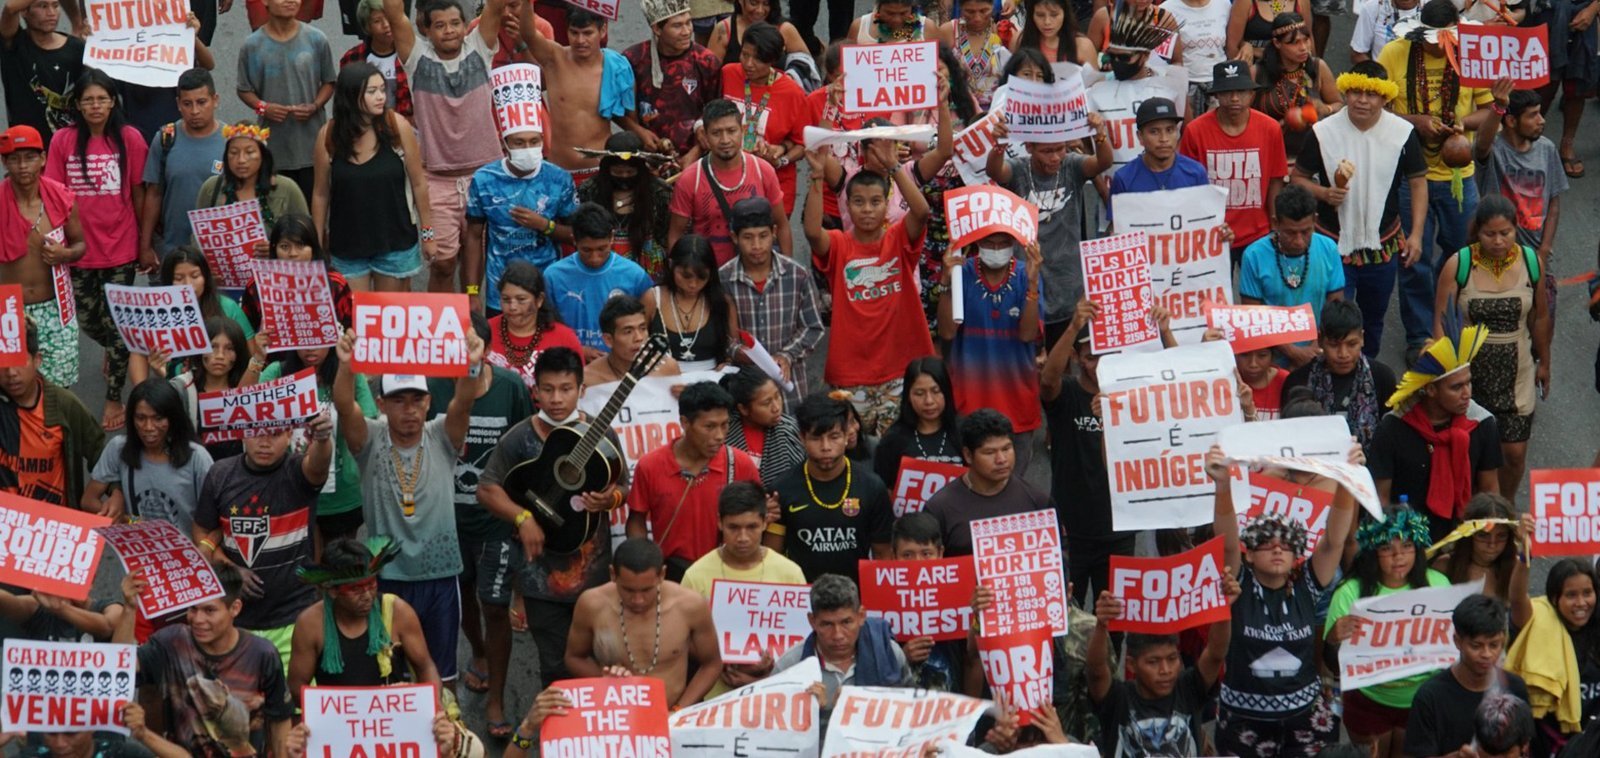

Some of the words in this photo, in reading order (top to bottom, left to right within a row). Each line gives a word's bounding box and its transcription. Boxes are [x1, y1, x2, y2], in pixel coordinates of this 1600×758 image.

[90, 0, 189, 31] FUTURO
[90, 44, 188, 65] INDÍGENA
[855, 50, 883, 65] WE
[890, 47, 925, 62] ARE
[1460, 35, 1546, 61] FORA
[874, 67, 908, 82] THE
[1460, 58, 1548, 80] GRILAGEM!
[857, 84, 926, 107] LAND
[1206, 151, 1262, 180] LUTA
[947, 192, 1034, 228] FORA
[195, 221, 228, 234] PLs
[231, 214, 259, 229] DA
[1171, 215, 1182, 230] O
[200, 226, 265, 249] MORTE:
[1147, 226, 1223, 266] UTURO
[1087, 256, 1119, 274] PLs
[1124, 248, 1147, 264] DA
[258, 271, 290, 289] PLs
[294, 274, 326, 290] DA
[1087, 265, 1151, 292] MORTE:
[1171, 268, 1183, 286] É
[260, 287, 330, 303] MORTE:
[848, 281, 902, 301] LACOSTE
[1102, 293, 1117, 304] PL
[1119, 290, 1133, 302] 191
[356, 305, 464, 338] FORA
[1106, 325, 1120, 336] PL
[1241, 322, 1310, 338] TERRAS!
[120, 326, 207, 354] VENENO
[354, 338, 467, 365] GRILAGEM!
[1161, 369, 1175, 381] O
[223, 383, 297, 408] MOTHER
[1107, 378, 1233, 426] FUTURO
[203, 389, 317, 426] EARTH
[205, 429, 237, 444] ALL
[1169, 424, 1183, 447] É
[233, 516, 267, 533] SPFC
[798, 527, 857, 546] QATAR
[812, 539, 858, 553] AIRWAYS
[978, 537, 1016, 556] PLs
[1023, 529, 1055, 549] DA
[15, 554, 88, 585] TERRAS!
[876, 568, 909, 586] WE
[916, 564, 959, 586] ARE
[979, 552, 1060, 577] MORTE:
[993, 578, 1010, 589] PL
[1013, 574, 1031, 586] 191
[1113, 553, 1220, 600] FORA
[152, 585, 169, 597] PL
[728, 588, 760, 606] WE
[767, 591, 809, 609] ARE
[896, 588, 938, 608] THE
[995, 590, 1011, 601] PL
[1015, 587, 1037, 599] 490
[997, 602, 1013, 614] PL
[1016, 597, 1046, 611] 2833
[1411, 604, 1426, 616] O
[748, 610, 787, 629] THE
[998, 614, 1014, 626] PL
[1018, 610, 1037, 622] 510
[1350, 617, 1452, 647] FUTUR
[7, 647, 105, 668] GARIMPO
[118, 650, 131, 669] É
[321, 695, 357, 714] WE
[368, 693, 417, 713] ARE
[563, 686, 595, 708] WE
[604, 685, 651, 706] ARE
[581, 709, 630, 732] THE
[674, 692, 812, 733] FUTURO
[840, 696, 982, 728] FUTURO
[346, 718, 394, 738] THE
[543, 735, 670, 758] MOUNTAINS
[733, 732, 749, 758] É
